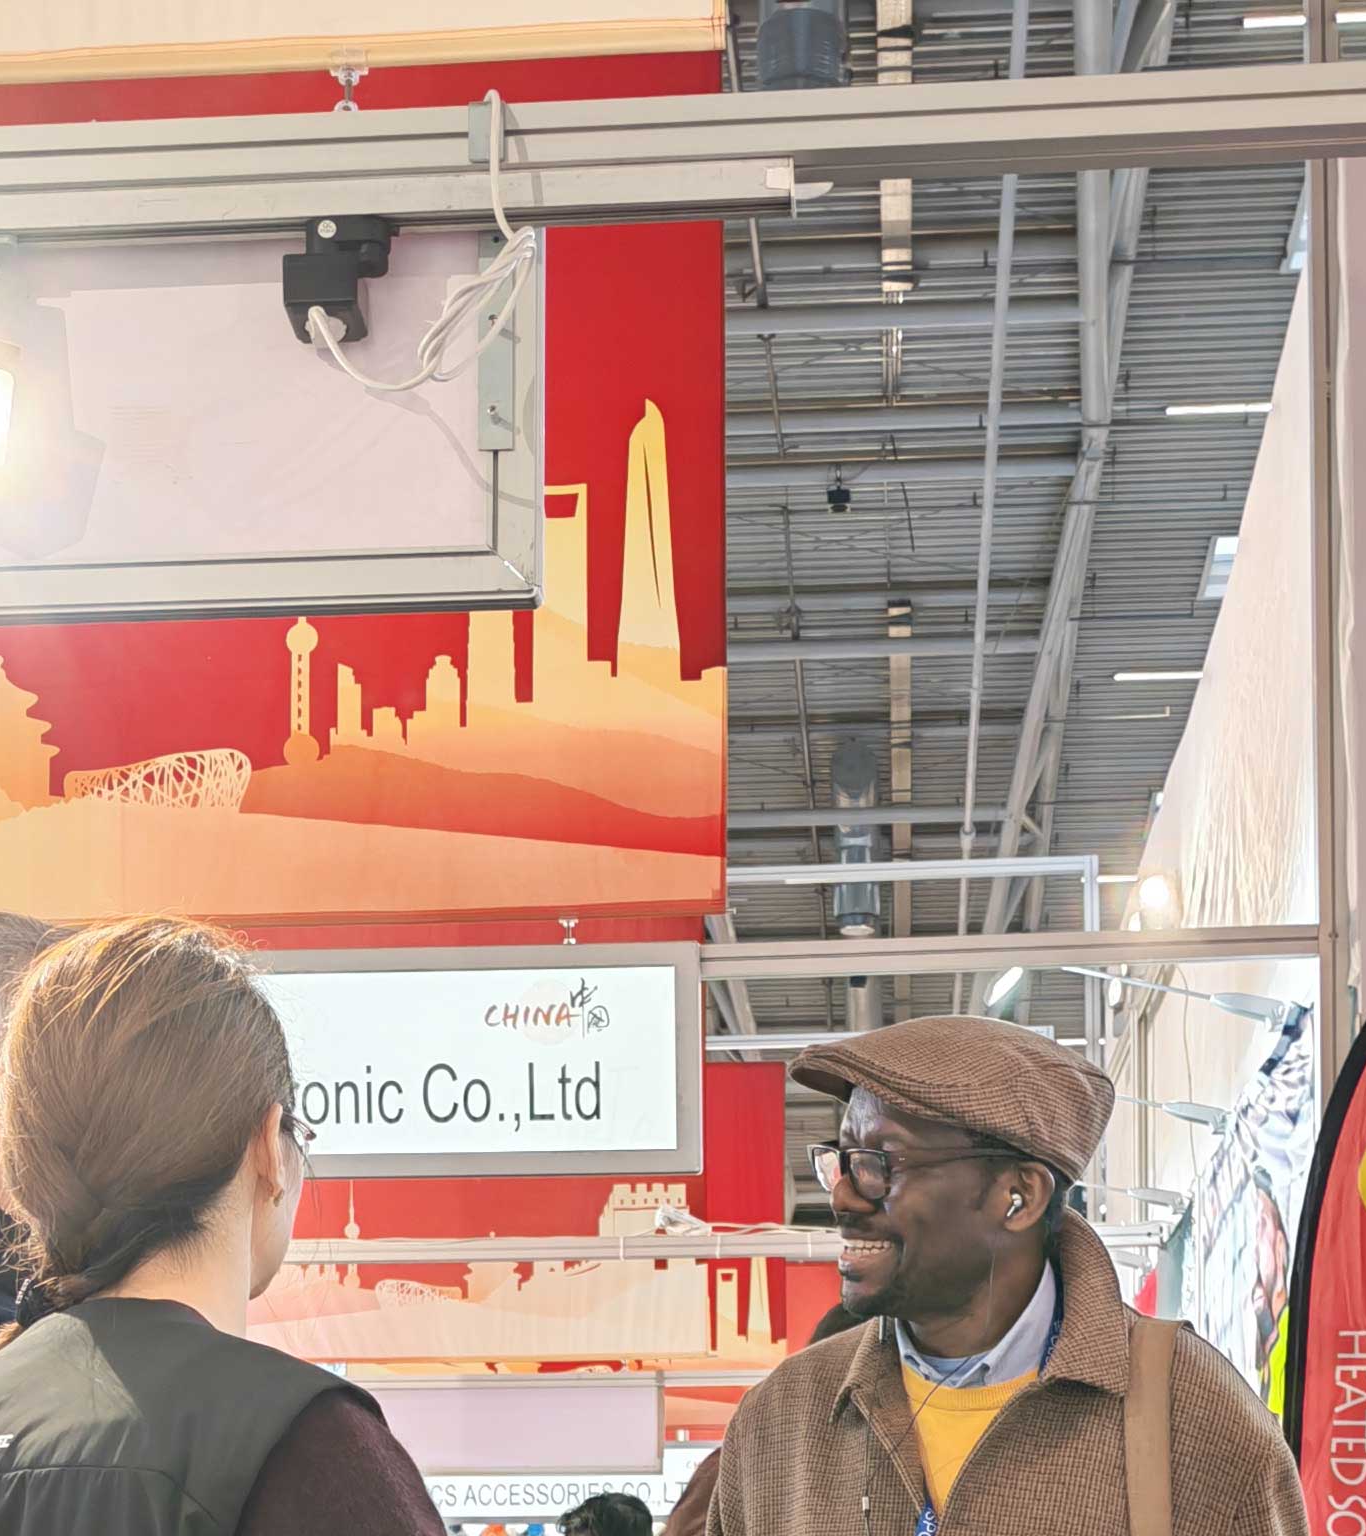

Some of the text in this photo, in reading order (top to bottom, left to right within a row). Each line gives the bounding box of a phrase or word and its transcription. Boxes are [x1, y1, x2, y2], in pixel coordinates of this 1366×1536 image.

[485, 1002, 571, 1030] CHINA
[301, 1065, 404, 1125] onic
[423, 1061, 602, 1132] Co.,Ltd
[429, 1484, 457, 1507] CS
